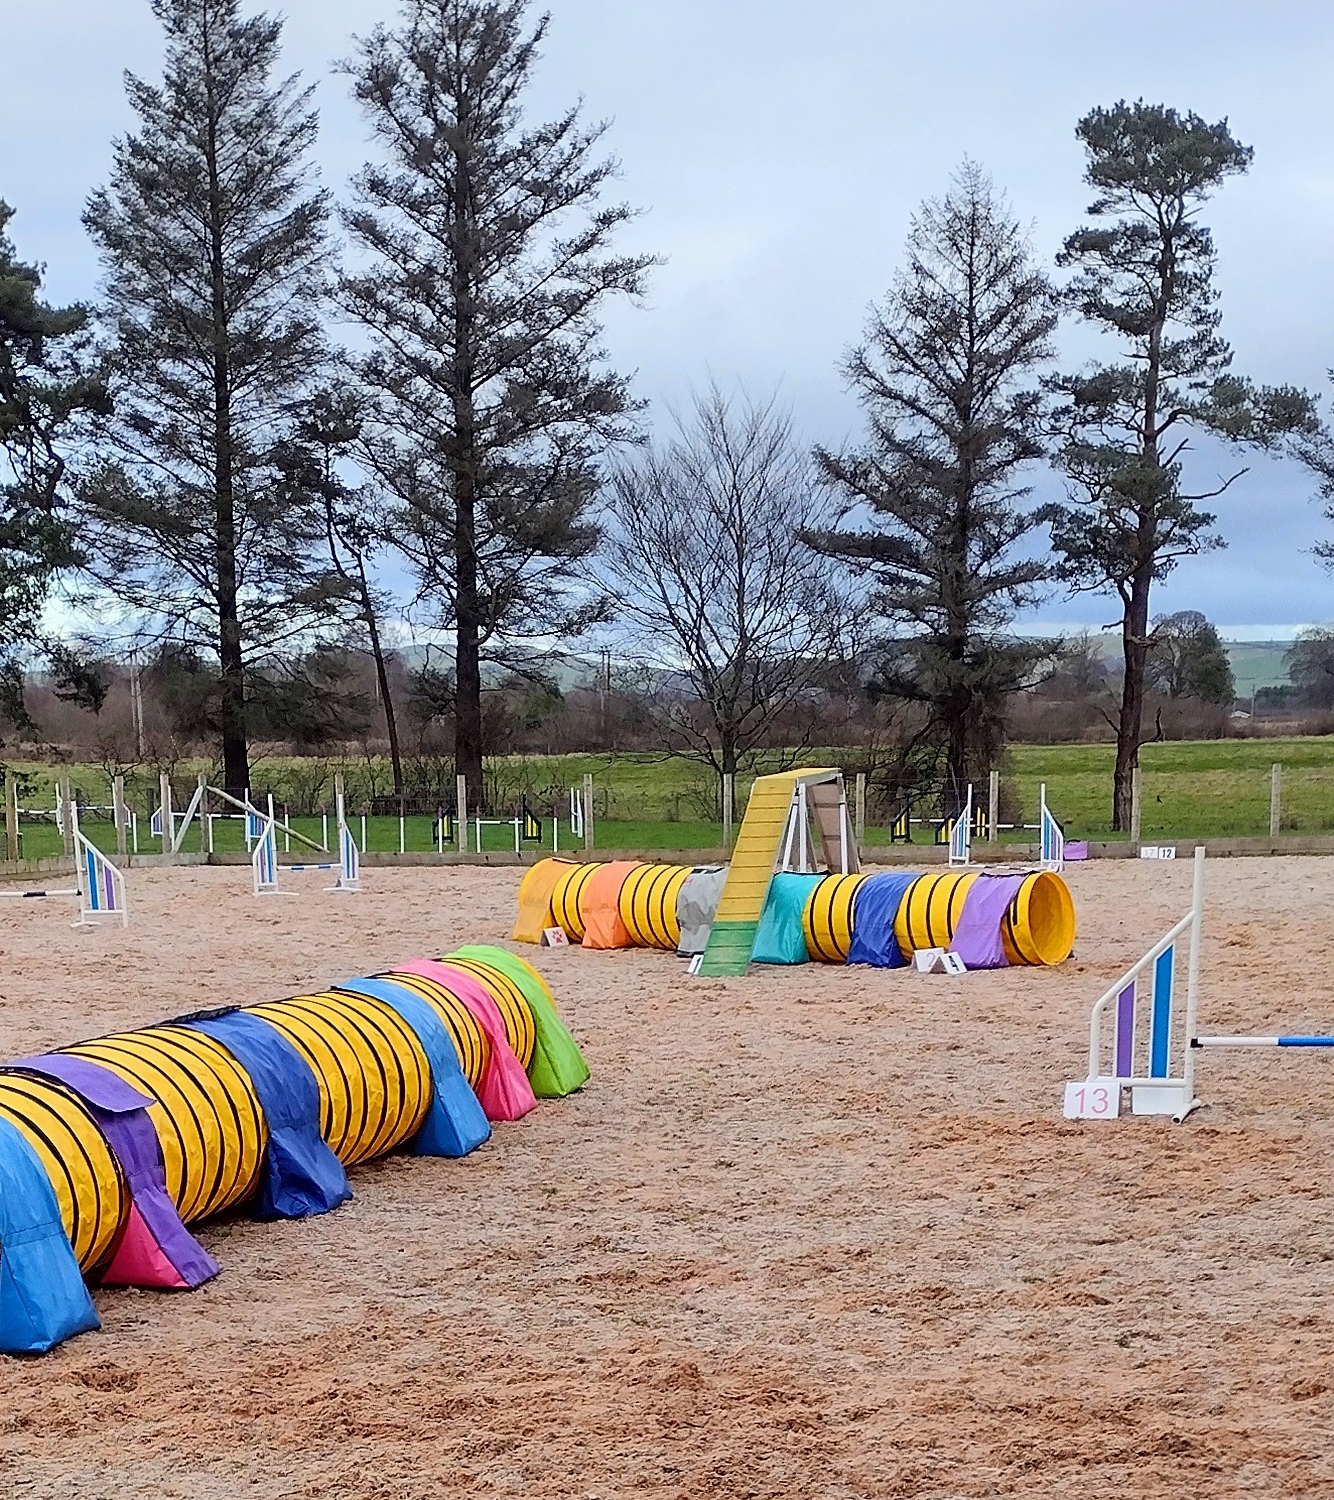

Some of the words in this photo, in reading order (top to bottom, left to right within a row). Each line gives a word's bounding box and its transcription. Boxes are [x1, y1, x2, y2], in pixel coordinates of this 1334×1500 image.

[1162, 848, 1172, 859] 12
[948, 955, 960, 972] 4
[1074, 1087, 1109, 1114] 13
